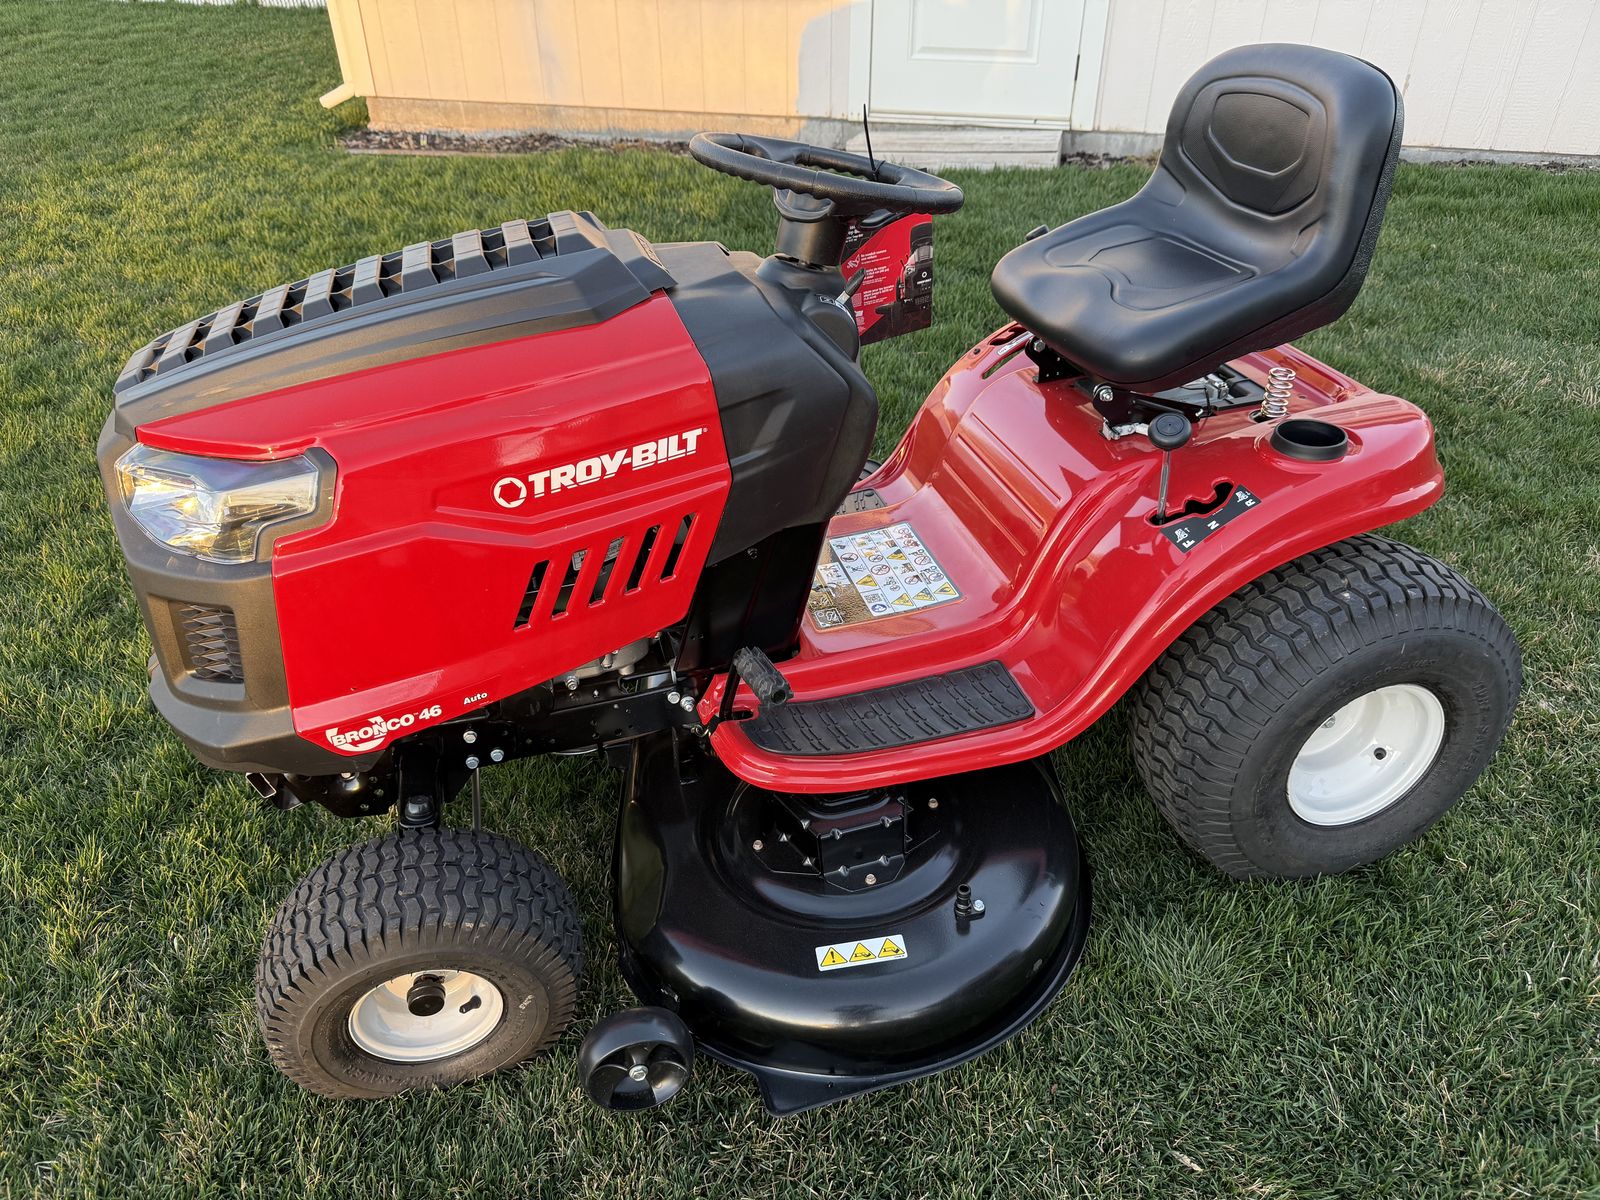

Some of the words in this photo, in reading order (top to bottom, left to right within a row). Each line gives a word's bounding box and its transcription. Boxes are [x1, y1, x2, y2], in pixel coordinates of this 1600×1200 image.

[528, 428, 703, 498] TROY-BILT
[1245, 499, 1256, 507] R
[1207, 520, 1220, 530] N
[1182, 539, 1195, 549] F
[463, 692, 488, 705] Auto
[332, 714, 414, 746] BRONCO
[418, 705, 442, 720] 46
